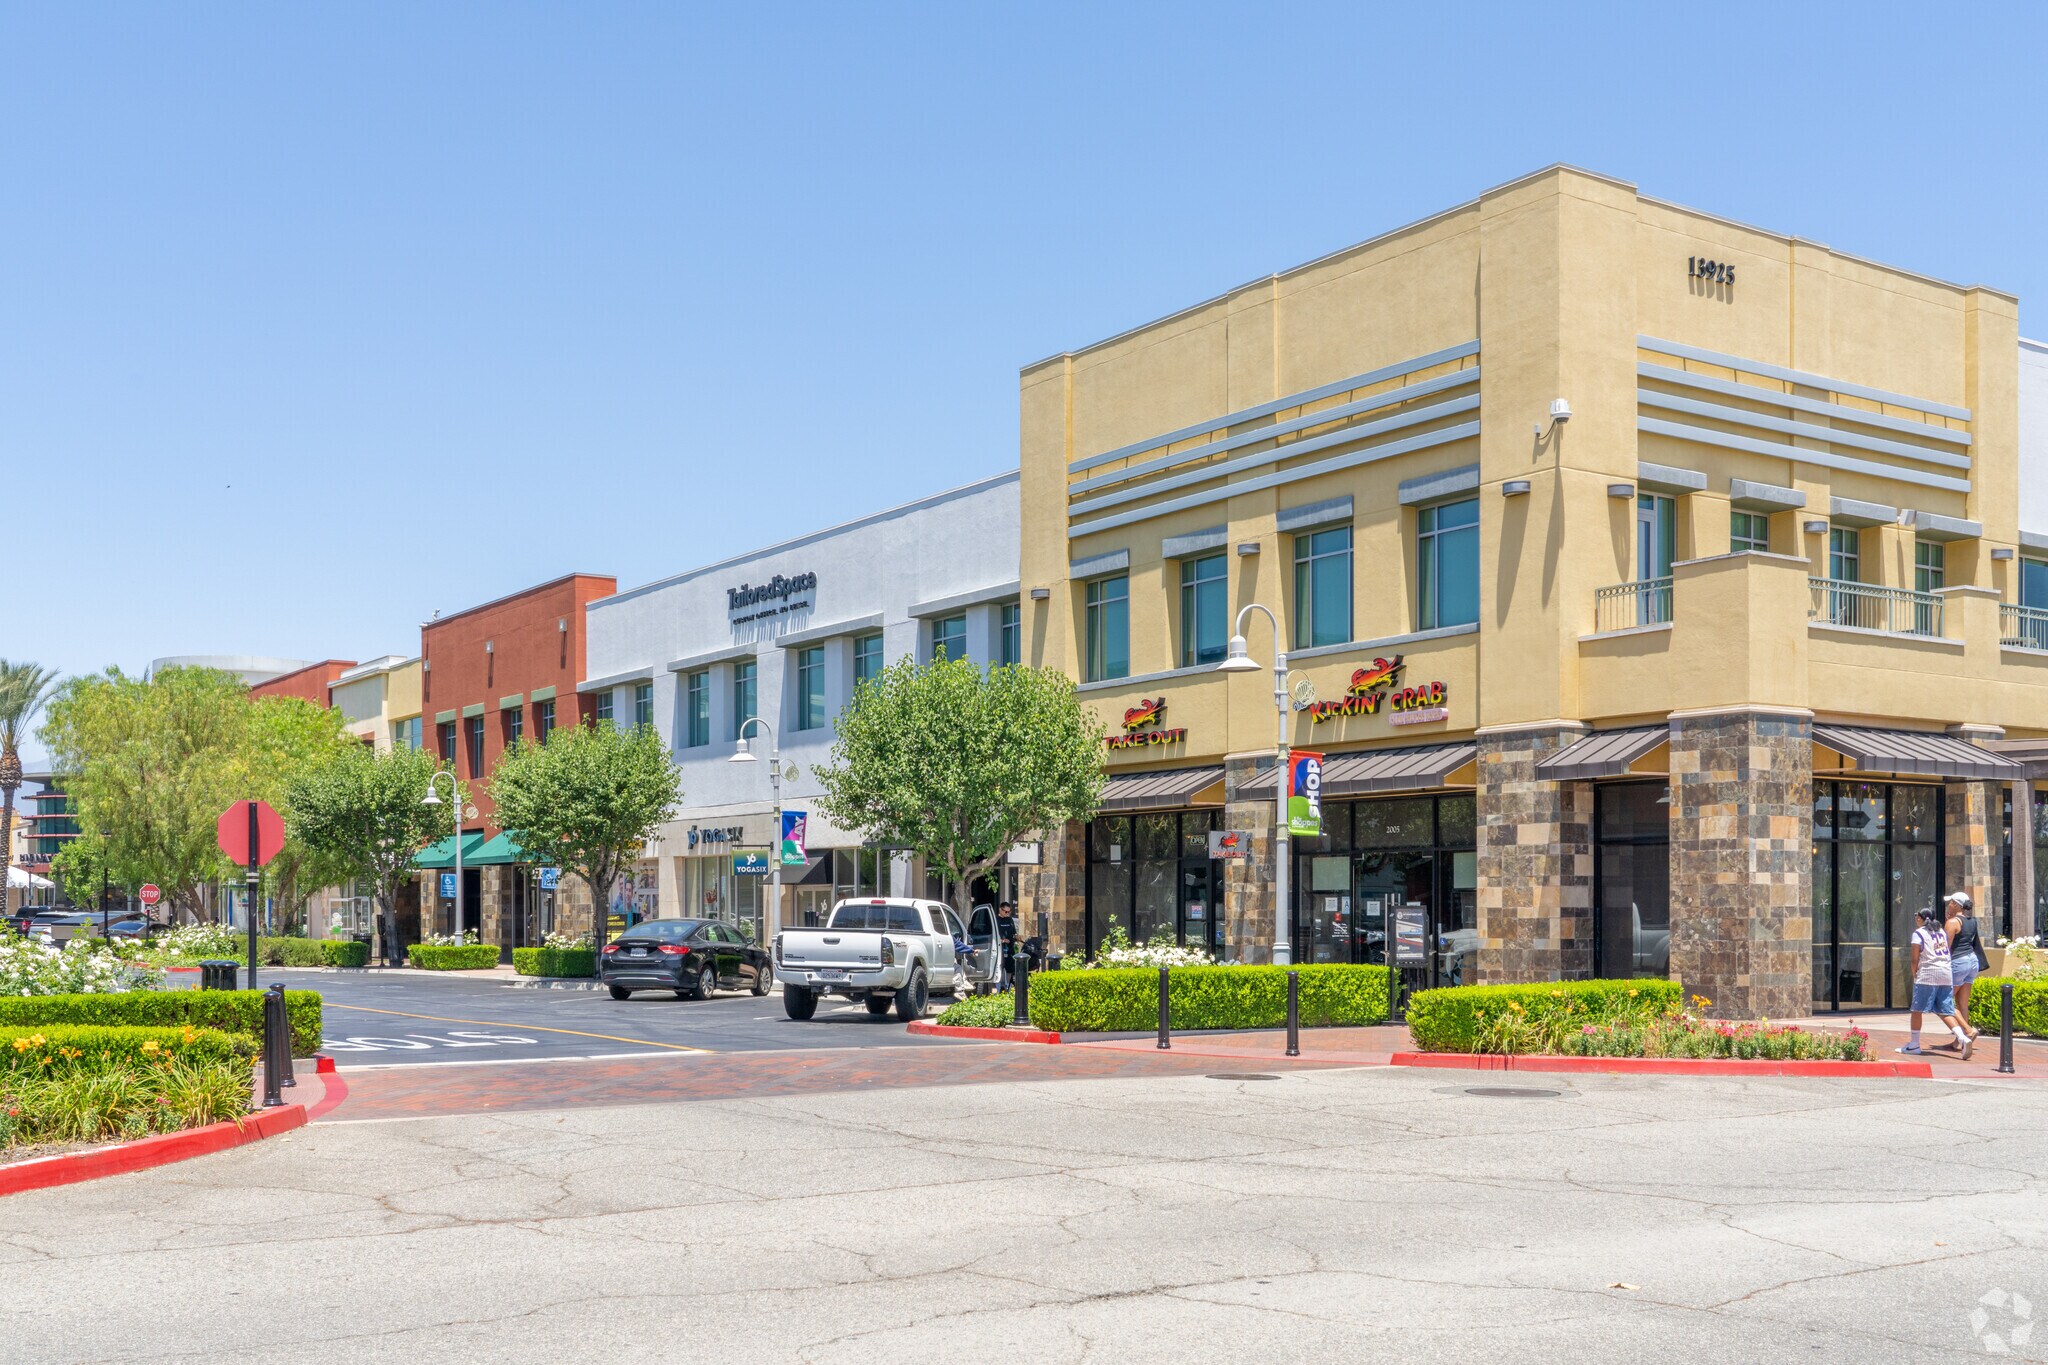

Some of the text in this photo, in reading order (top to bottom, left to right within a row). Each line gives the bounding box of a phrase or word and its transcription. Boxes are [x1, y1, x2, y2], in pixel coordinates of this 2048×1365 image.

[727, 571, 817, 610] TailoredSpace
[1391, 681, 1447, 711] CRAB
[1103, 728, 1184, 750] TAKE OUT
[1306, 759, 1321, 819] SHOP
[700, 826, 744, 844] YOGASIX
[794, 815, 806, 854] PLAY
[1386, 825, 1400, 834] 2005
[141, 889, 159, 898] STOP
